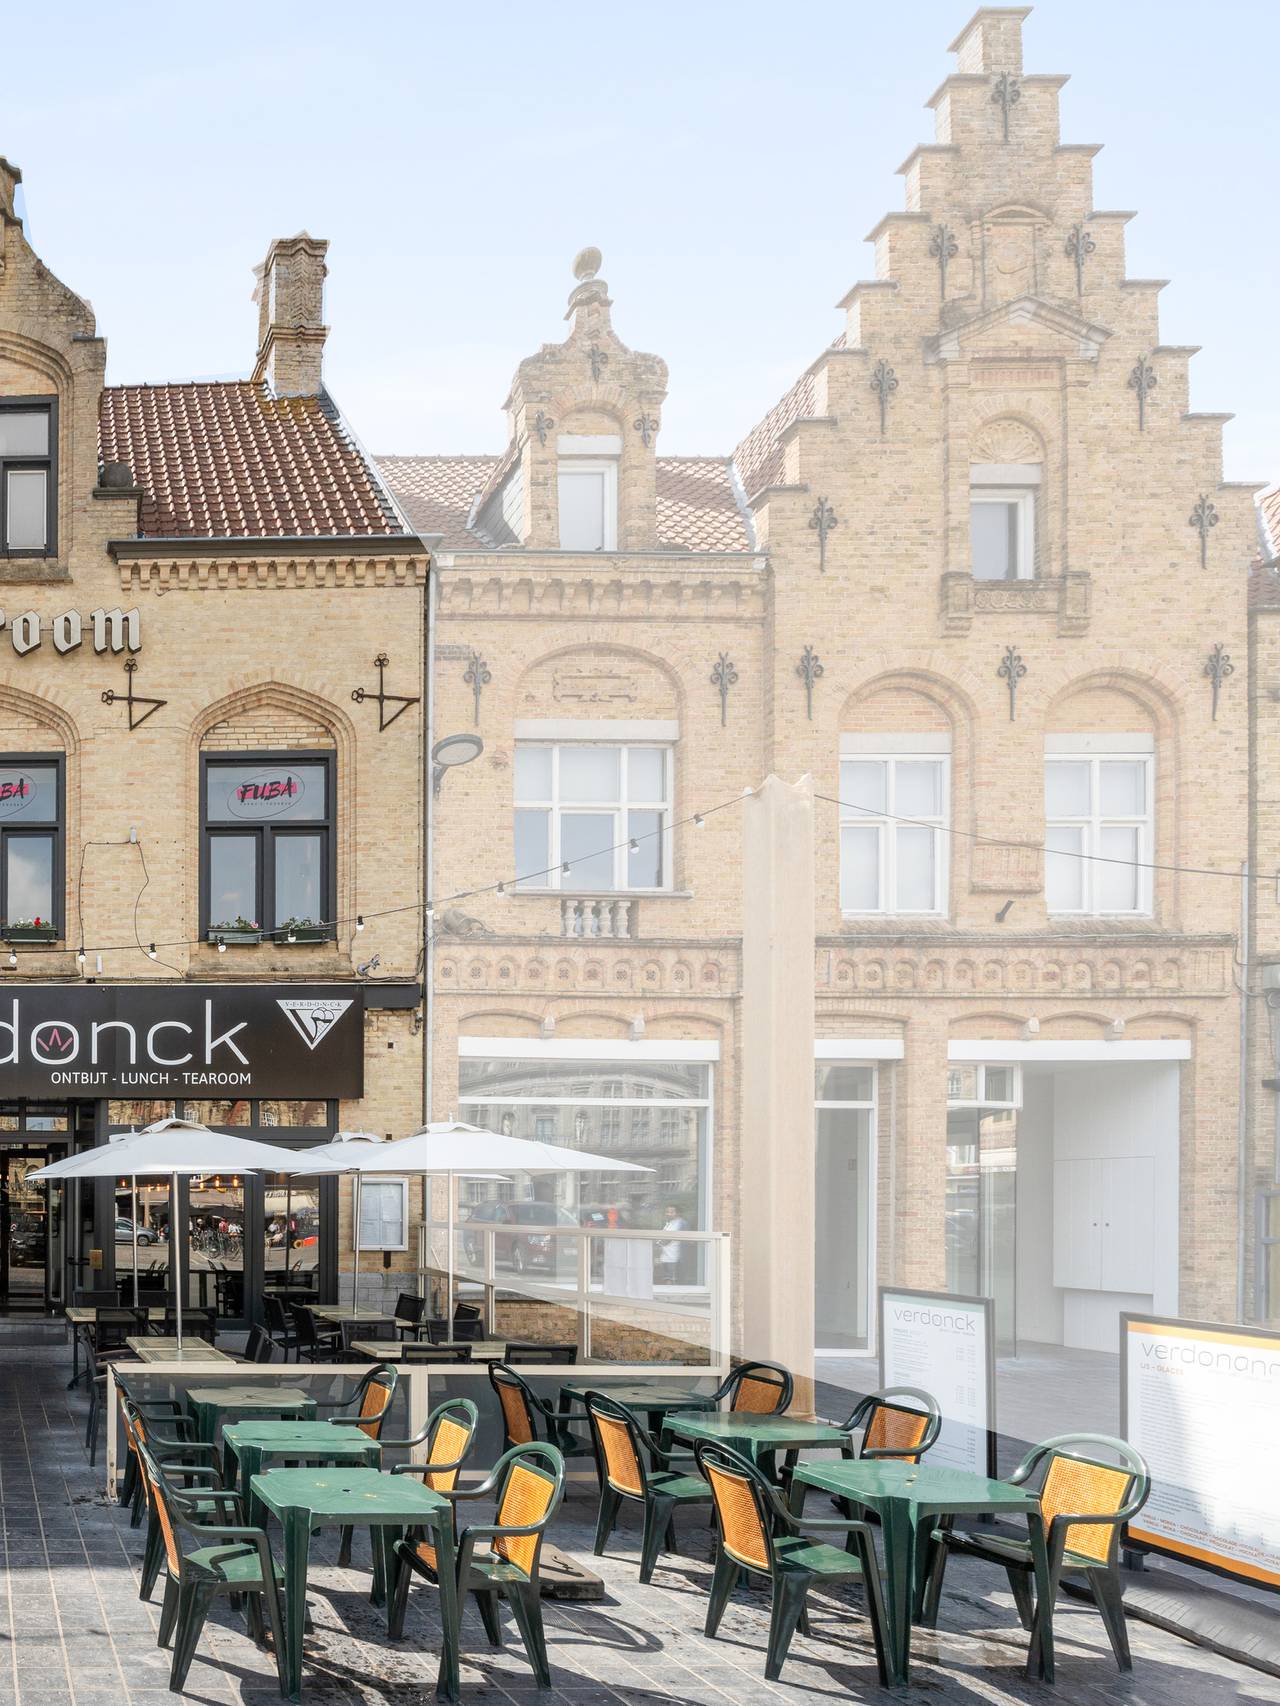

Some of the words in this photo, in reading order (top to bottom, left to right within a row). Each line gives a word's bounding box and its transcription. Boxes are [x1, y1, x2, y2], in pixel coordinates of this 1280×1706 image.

[240, 776, 293, 803] FUBA
[50, 1072, 108, 1085] ONTBIJT
[121, 1072, 169, 1085] LUNCH
[182, 1072, 251, 1085] TEAROOM
[894, 1308, 976, 1333] verdonck
